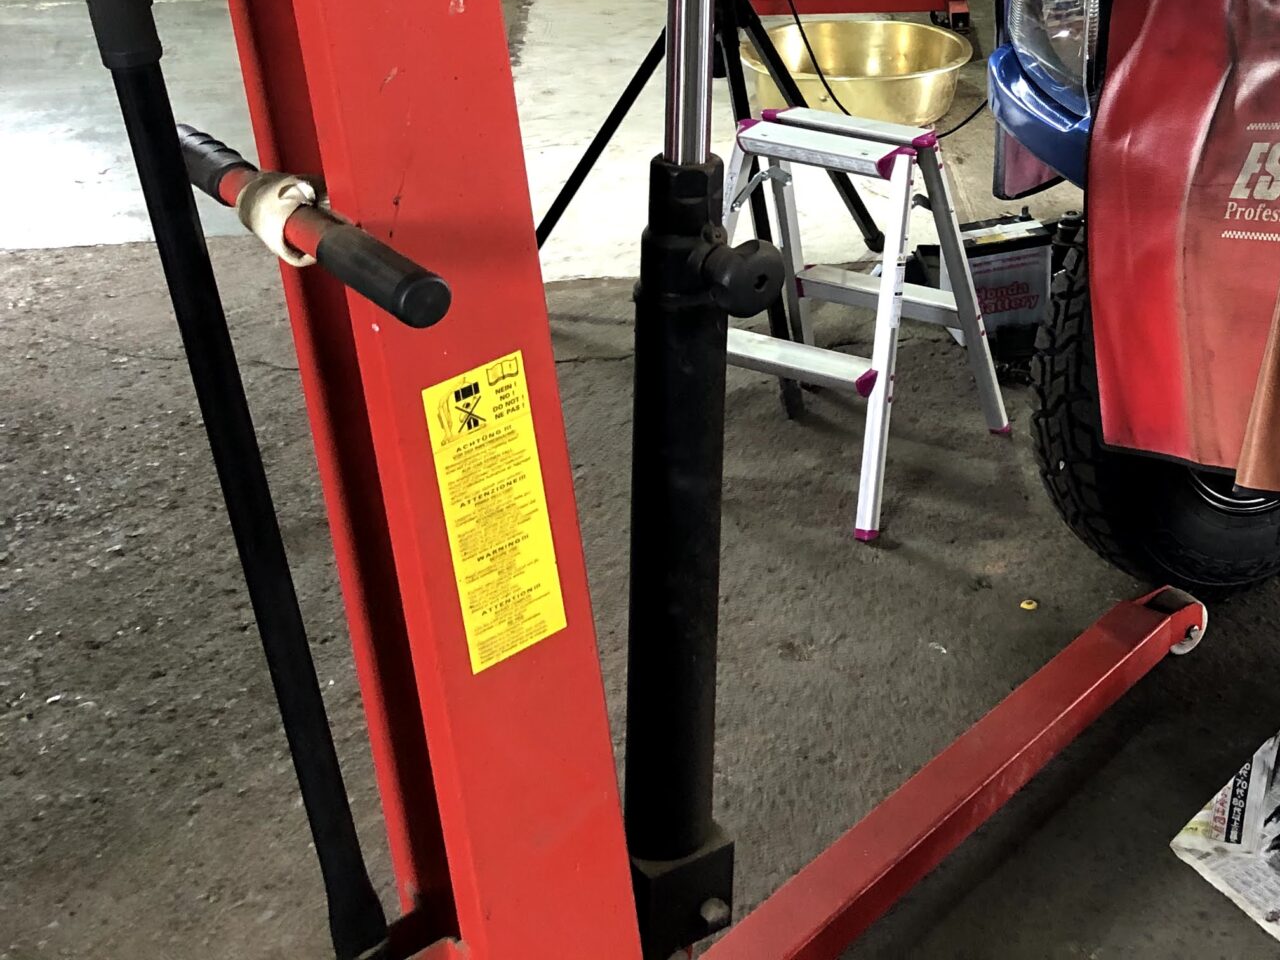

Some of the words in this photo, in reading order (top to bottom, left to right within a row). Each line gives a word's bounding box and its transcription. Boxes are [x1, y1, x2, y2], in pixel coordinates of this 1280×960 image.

[979, 294, 1040, 315] attery
[495, 383, 512, 395] NEIN
[499, 392, 511, 401] NO
[492, 403, 504, 413] DO
[505, 396, 519, 407] NOT
[506, 404, 520, 415] PAS
